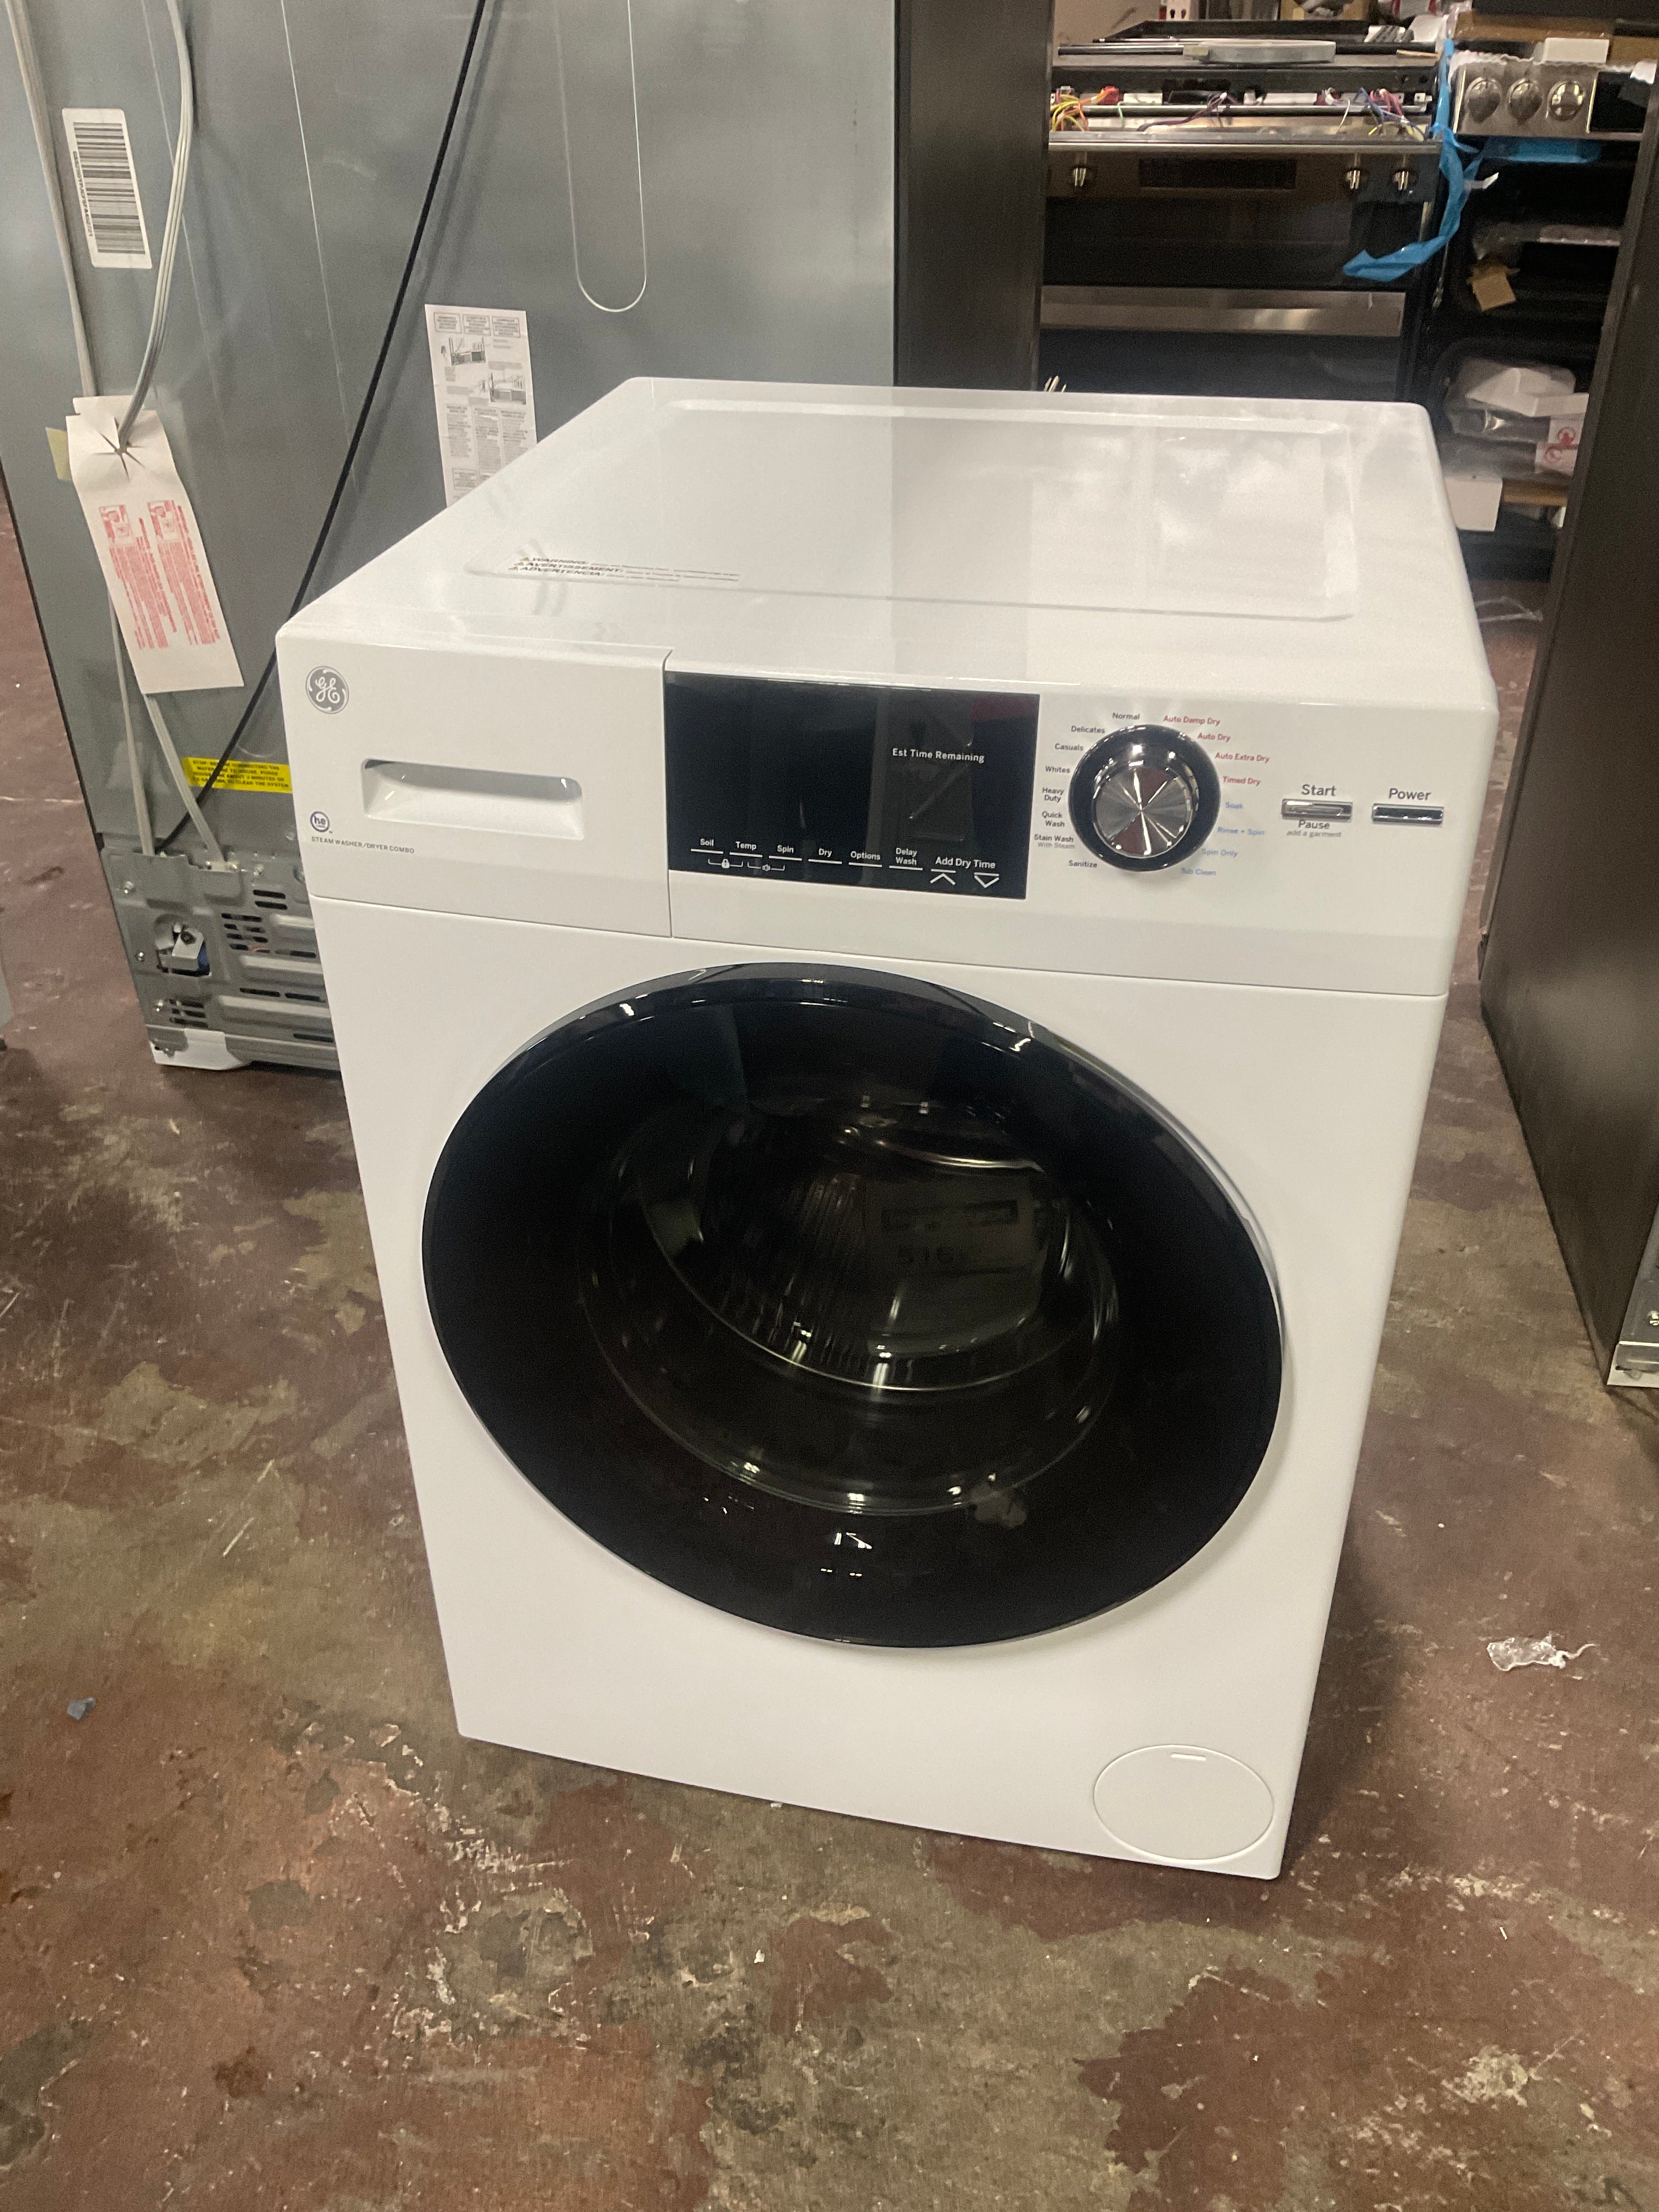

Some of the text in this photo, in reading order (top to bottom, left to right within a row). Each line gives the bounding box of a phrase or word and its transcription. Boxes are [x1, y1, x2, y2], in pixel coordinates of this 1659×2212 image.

[1112, 712, 1141, 720] Normal
[1164, 715, 1221, 726] Auto Damp Dry
[1071, 725, 1105, 733] Delicates
[1217, 734, 1231, 743] Dry
[1054, 743, 1084, 751] Casuals
[892, 748, 985, 764] Est Time Remaining
[1256, 754, 1269, 764] Dry
[1222, 776, 1261, 786] Timed Dry
[1042, 787, 1064, 795] Heavy
[1301, 783, 1337, 797] Start
[1388, 787, 1431, 801] Power
[1044, 794, 1062, 803] Duty
[1298, 819, 1330, 830] Pause
[1034, 833, 1052, 842] Stain
[1308, 830, 1342, 838] garment
[700, 838, 714, 847] Soil
[735, 841, 757, 851] Temp
[389, 845, 415, 854] COMBO
[777, 844, 794, 854] Spin
[818, 848, 832, 857] Dry
[895, 847, 918, 857] Delay
[1220, 848, 1238, 858] Only
[850, 850, 881, 860] Options
[895, 856, 917, 866] Wash
[935, 856, 996, 870] Add Dry Time
[1068, 860, 1098, 868] Sanitize
